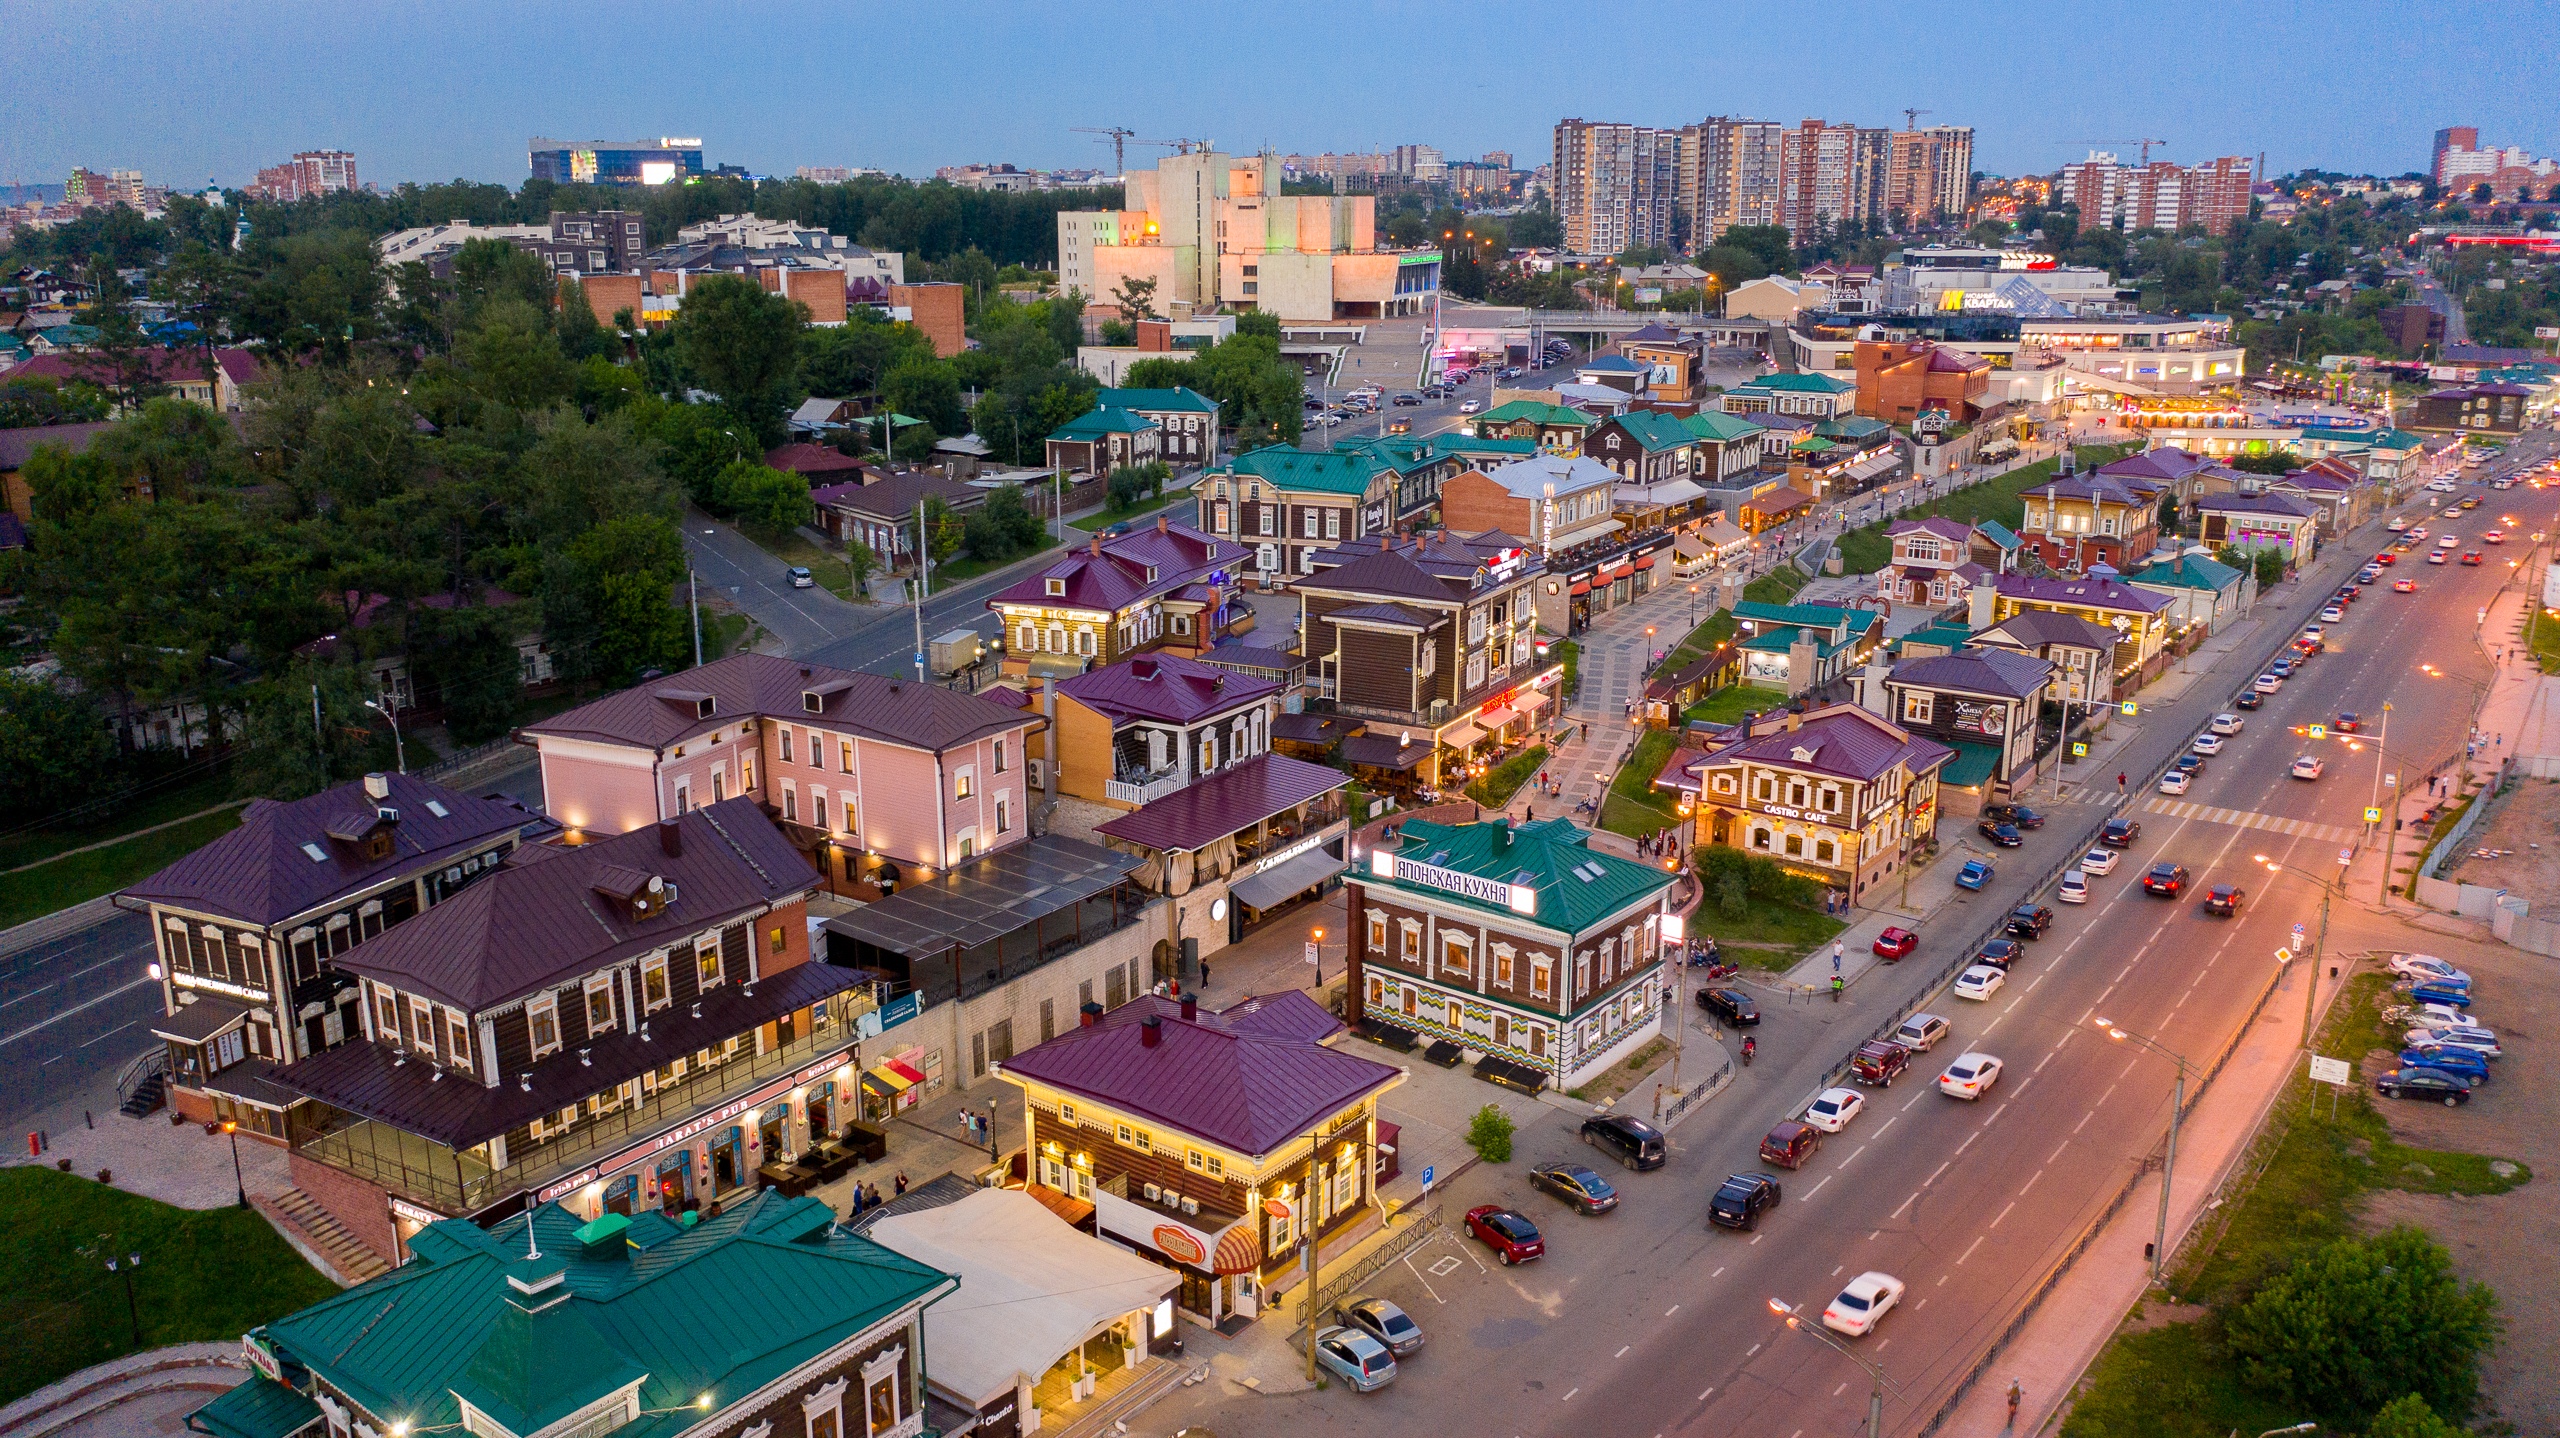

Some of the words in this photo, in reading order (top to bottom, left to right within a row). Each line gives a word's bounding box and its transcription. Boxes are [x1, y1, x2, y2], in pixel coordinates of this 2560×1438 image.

[2000, 260, 2027, 269] КИНО
[1964, 299, 2015, 309] КВАРТАЛ
[1763, 804, 1799, 818] CASTRO
[1804, 811, 1828, 824] CAFE
[1398, 861, 1462, 892] ЯПОНСКАЯ
[1464, 877, 1507, 903] КУХНЯ
[243, 987, 269, 1001] САЛОН
[808, 1064, 826, 1077] Irish
[826, 1059, 839, 1070] pub
[655, 1117, 715, 1149] HARAT'S
[722, 1100, 749, 1119] PUB
[549, 1181, 572, 1197] Irish
[572, 1173, 590, 1188] pub
[395, 1203, 432, 1223] HARAT'S
